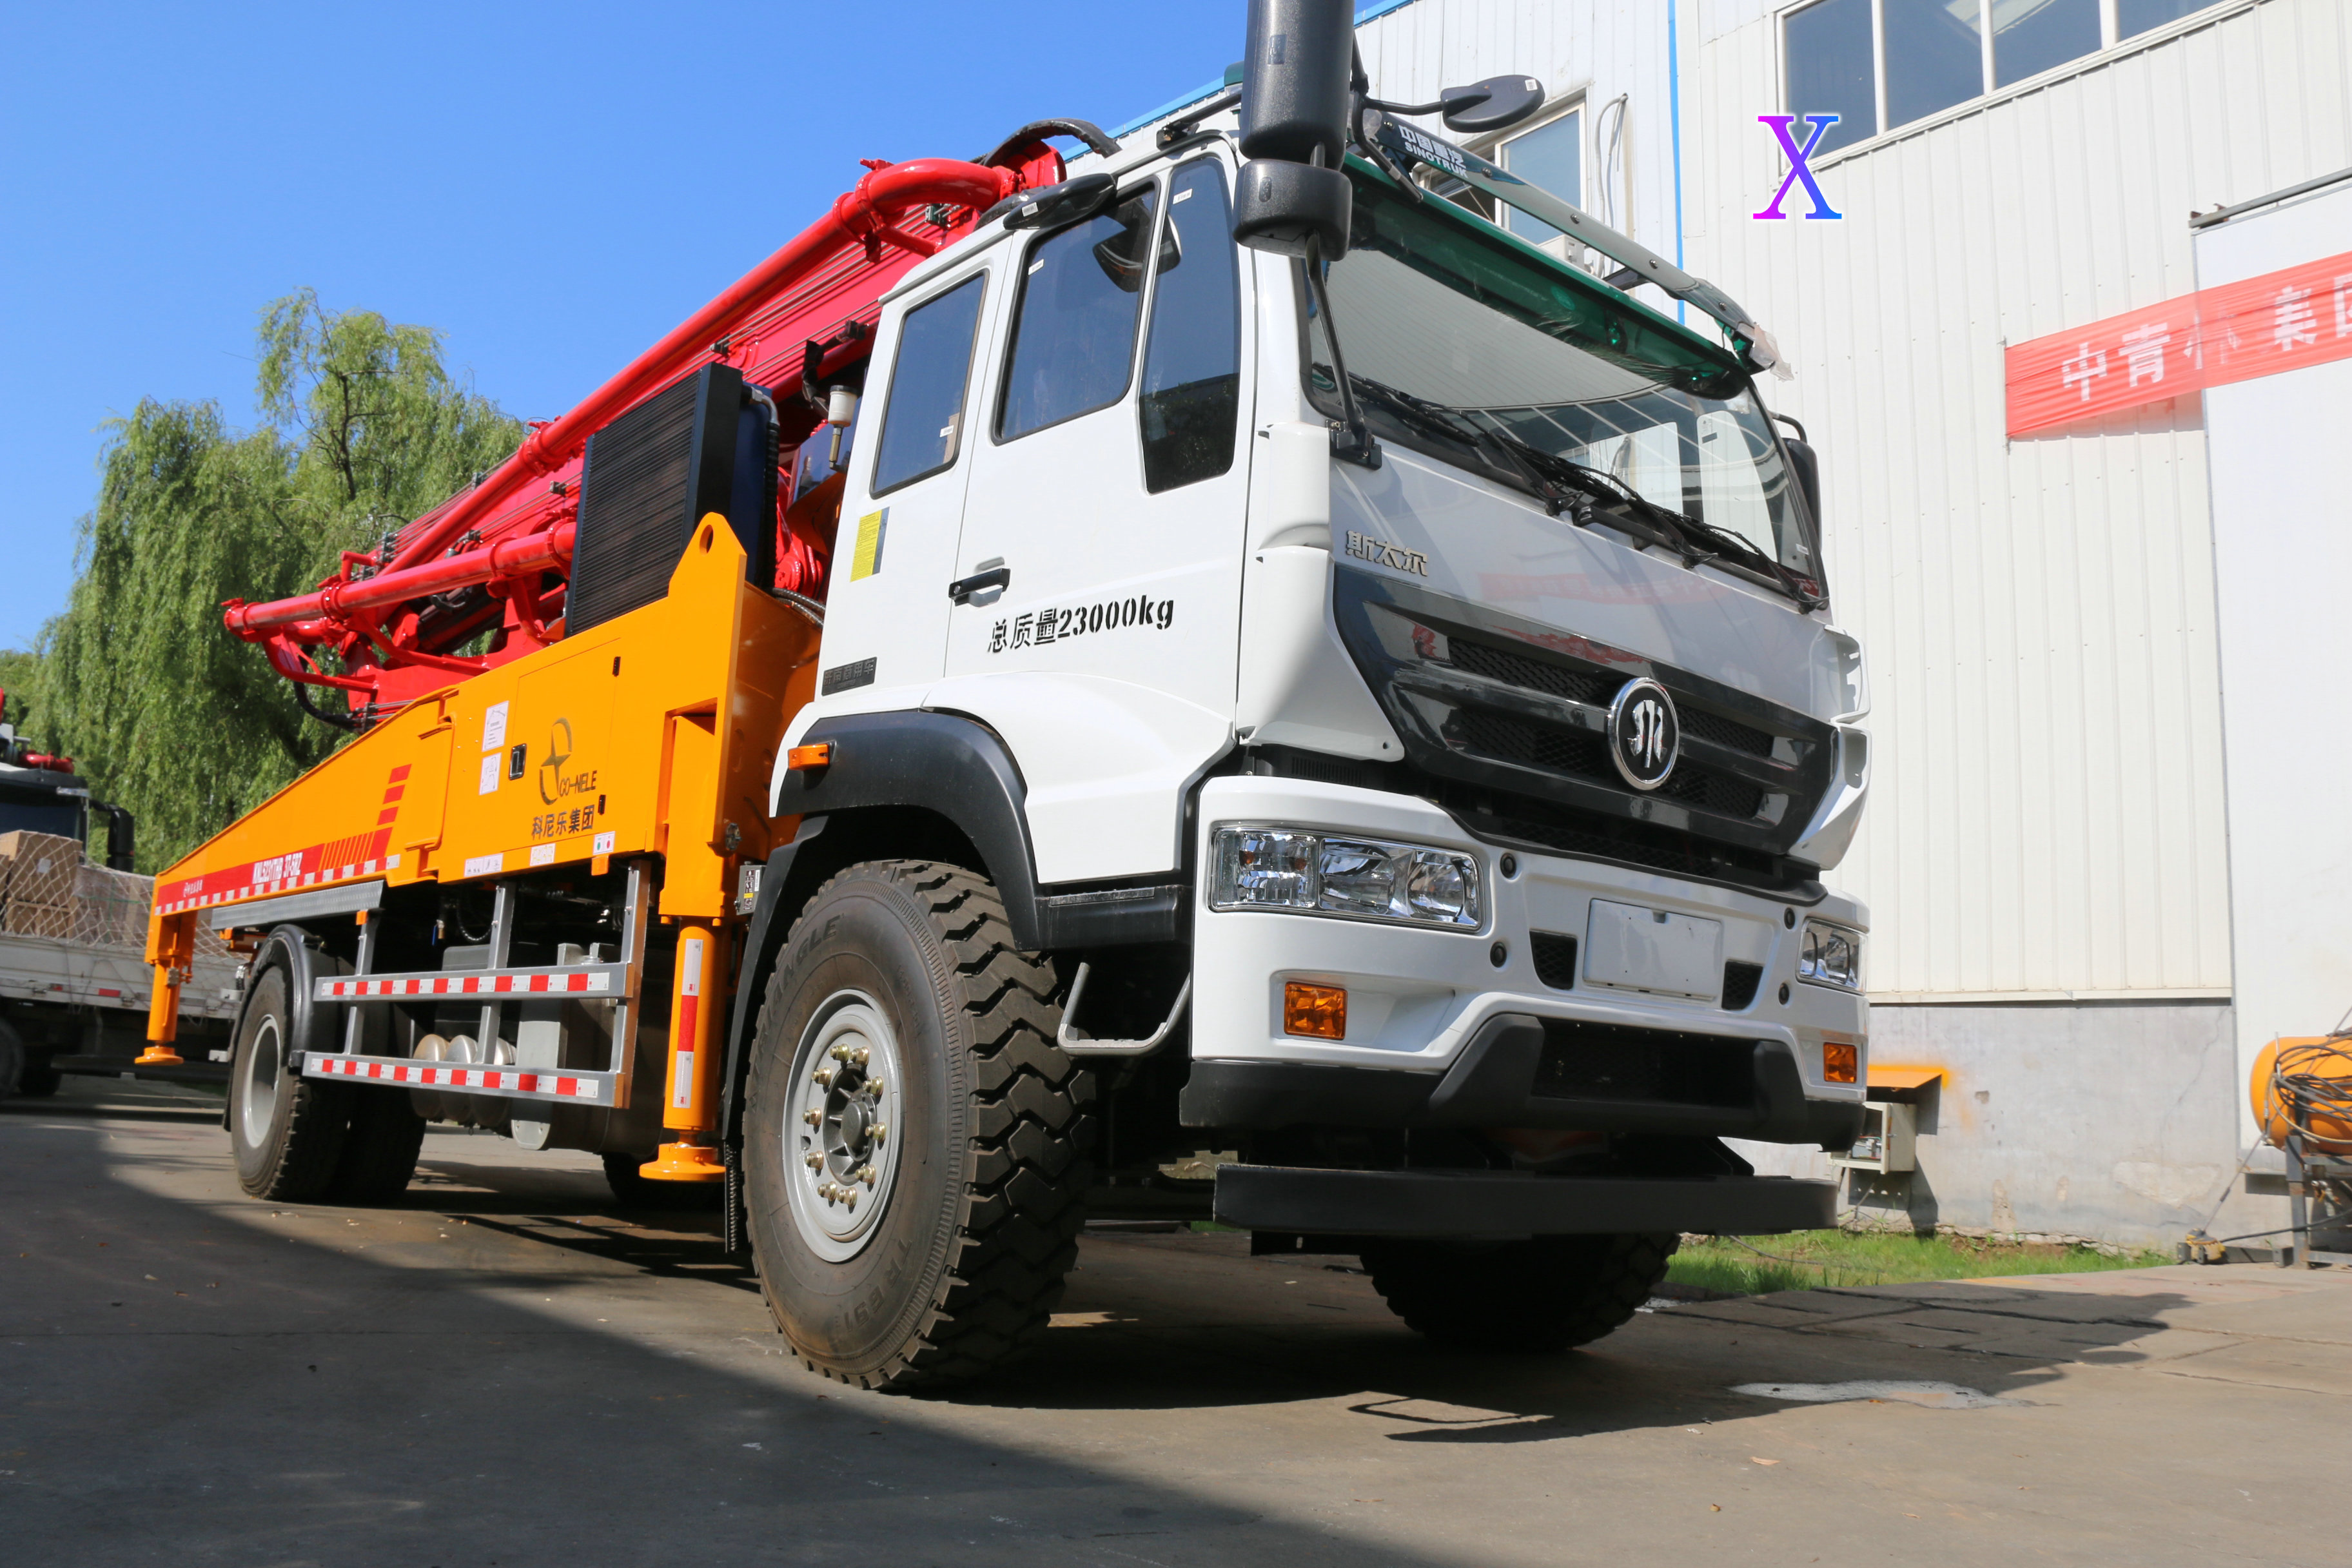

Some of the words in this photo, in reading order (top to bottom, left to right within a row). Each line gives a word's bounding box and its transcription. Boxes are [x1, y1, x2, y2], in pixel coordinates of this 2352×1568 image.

[1398, 125, 1467, 169] 中国重汽
[1405, 143, 1469, 179] SINOTRUK
[1346, 530, 1429, 576] 斯太尔
[531, 804, 595, 841] 科尼乐集团
